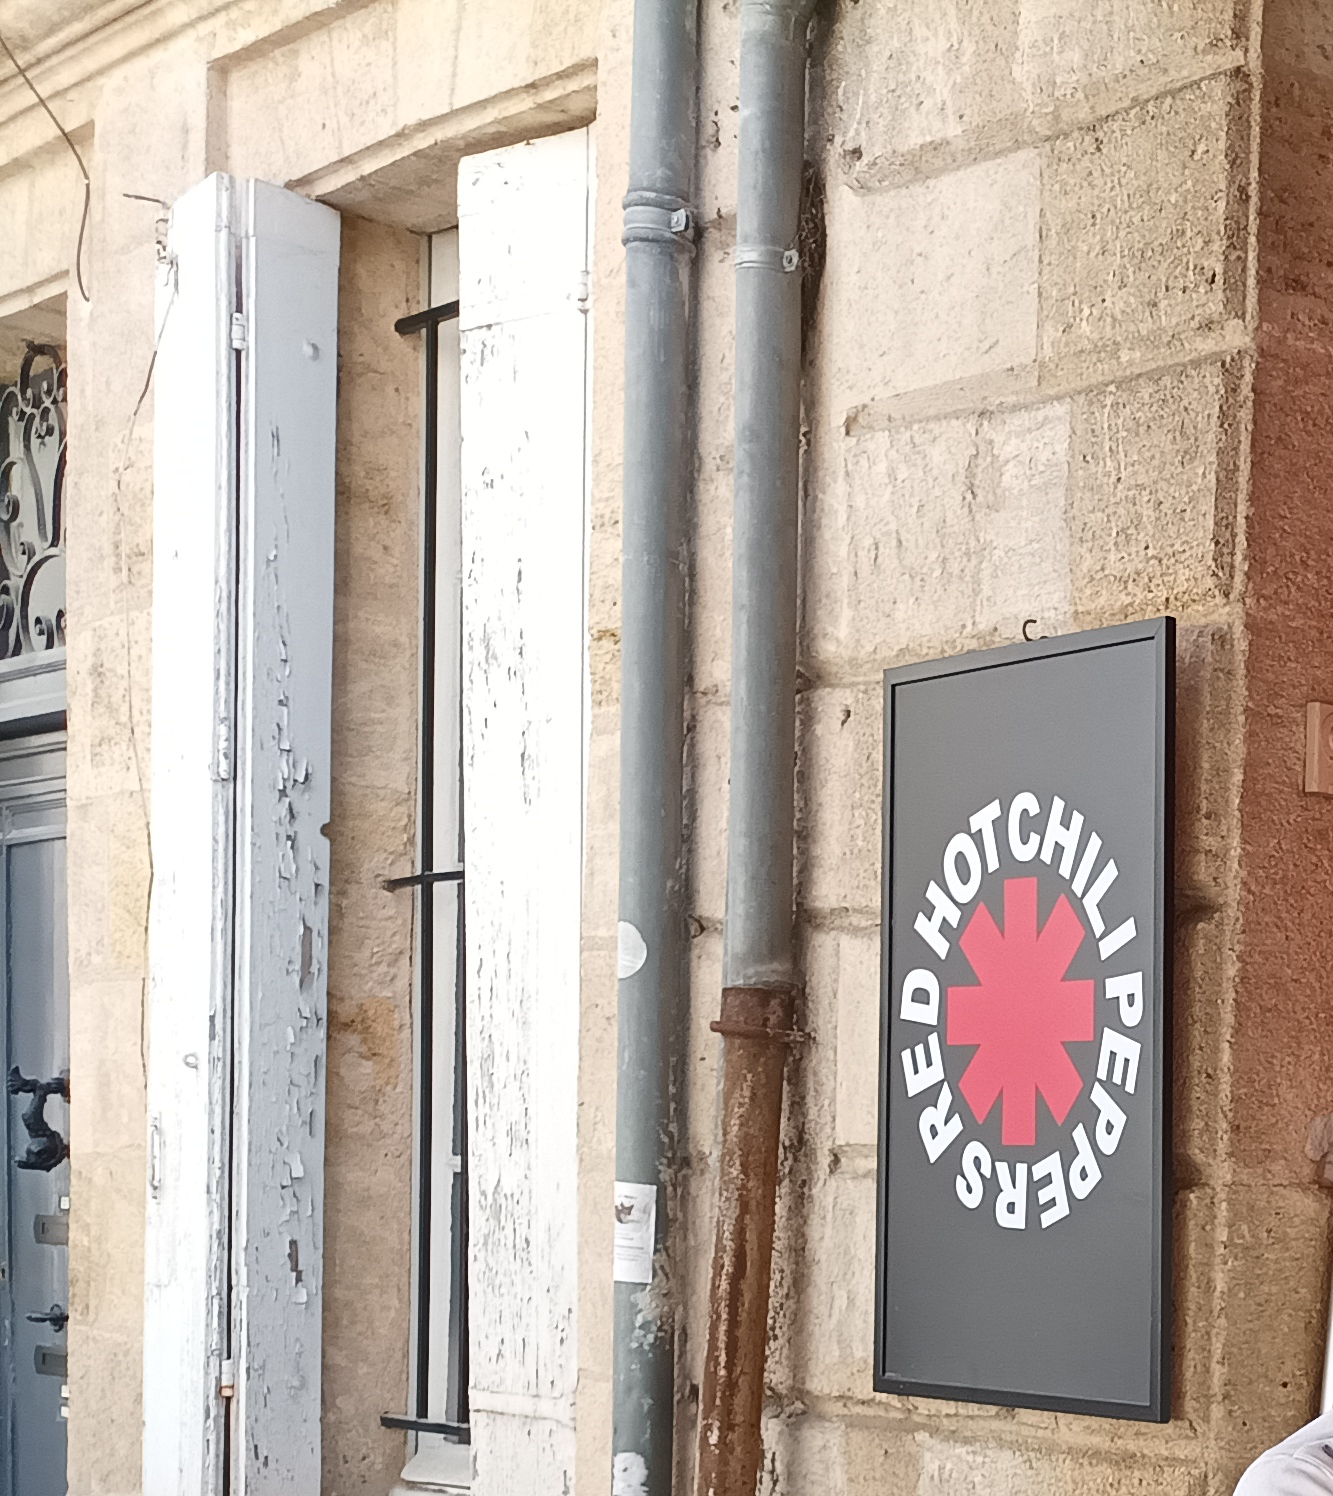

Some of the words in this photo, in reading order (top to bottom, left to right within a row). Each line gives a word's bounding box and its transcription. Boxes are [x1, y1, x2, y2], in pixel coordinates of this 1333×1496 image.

[913, 798, 1002, 961] HOT
[1007, 792, 1137, 962] CHILI
[900, 968, 964, 1164] RED
[955, 971, 1144, 1230] PEPPERS
